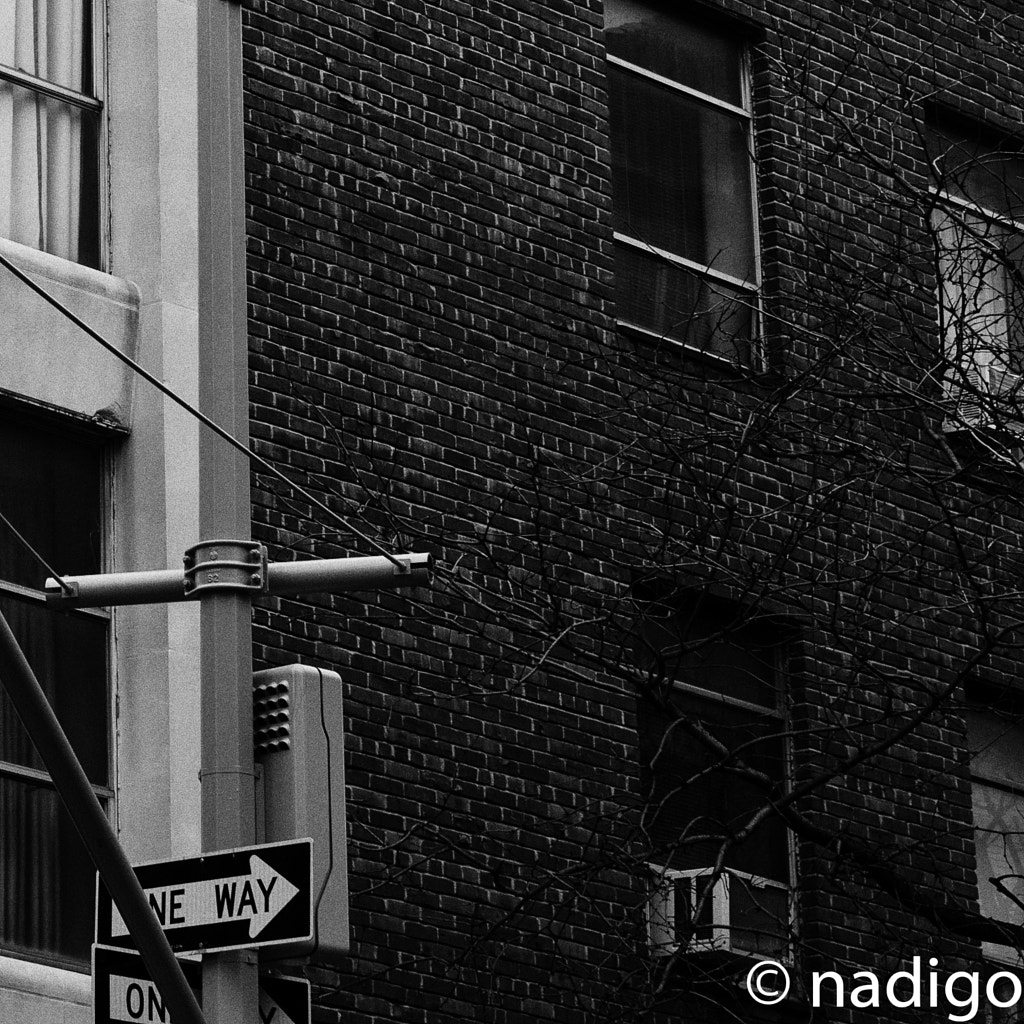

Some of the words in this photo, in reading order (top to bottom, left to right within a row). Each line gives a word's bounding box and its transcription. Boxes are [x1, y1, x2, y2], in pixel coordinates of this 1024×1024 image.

[147, 888, 186, 926] NE
[214, 876, 278, 919] WAY
[126, 982, 167, 1023] ON
